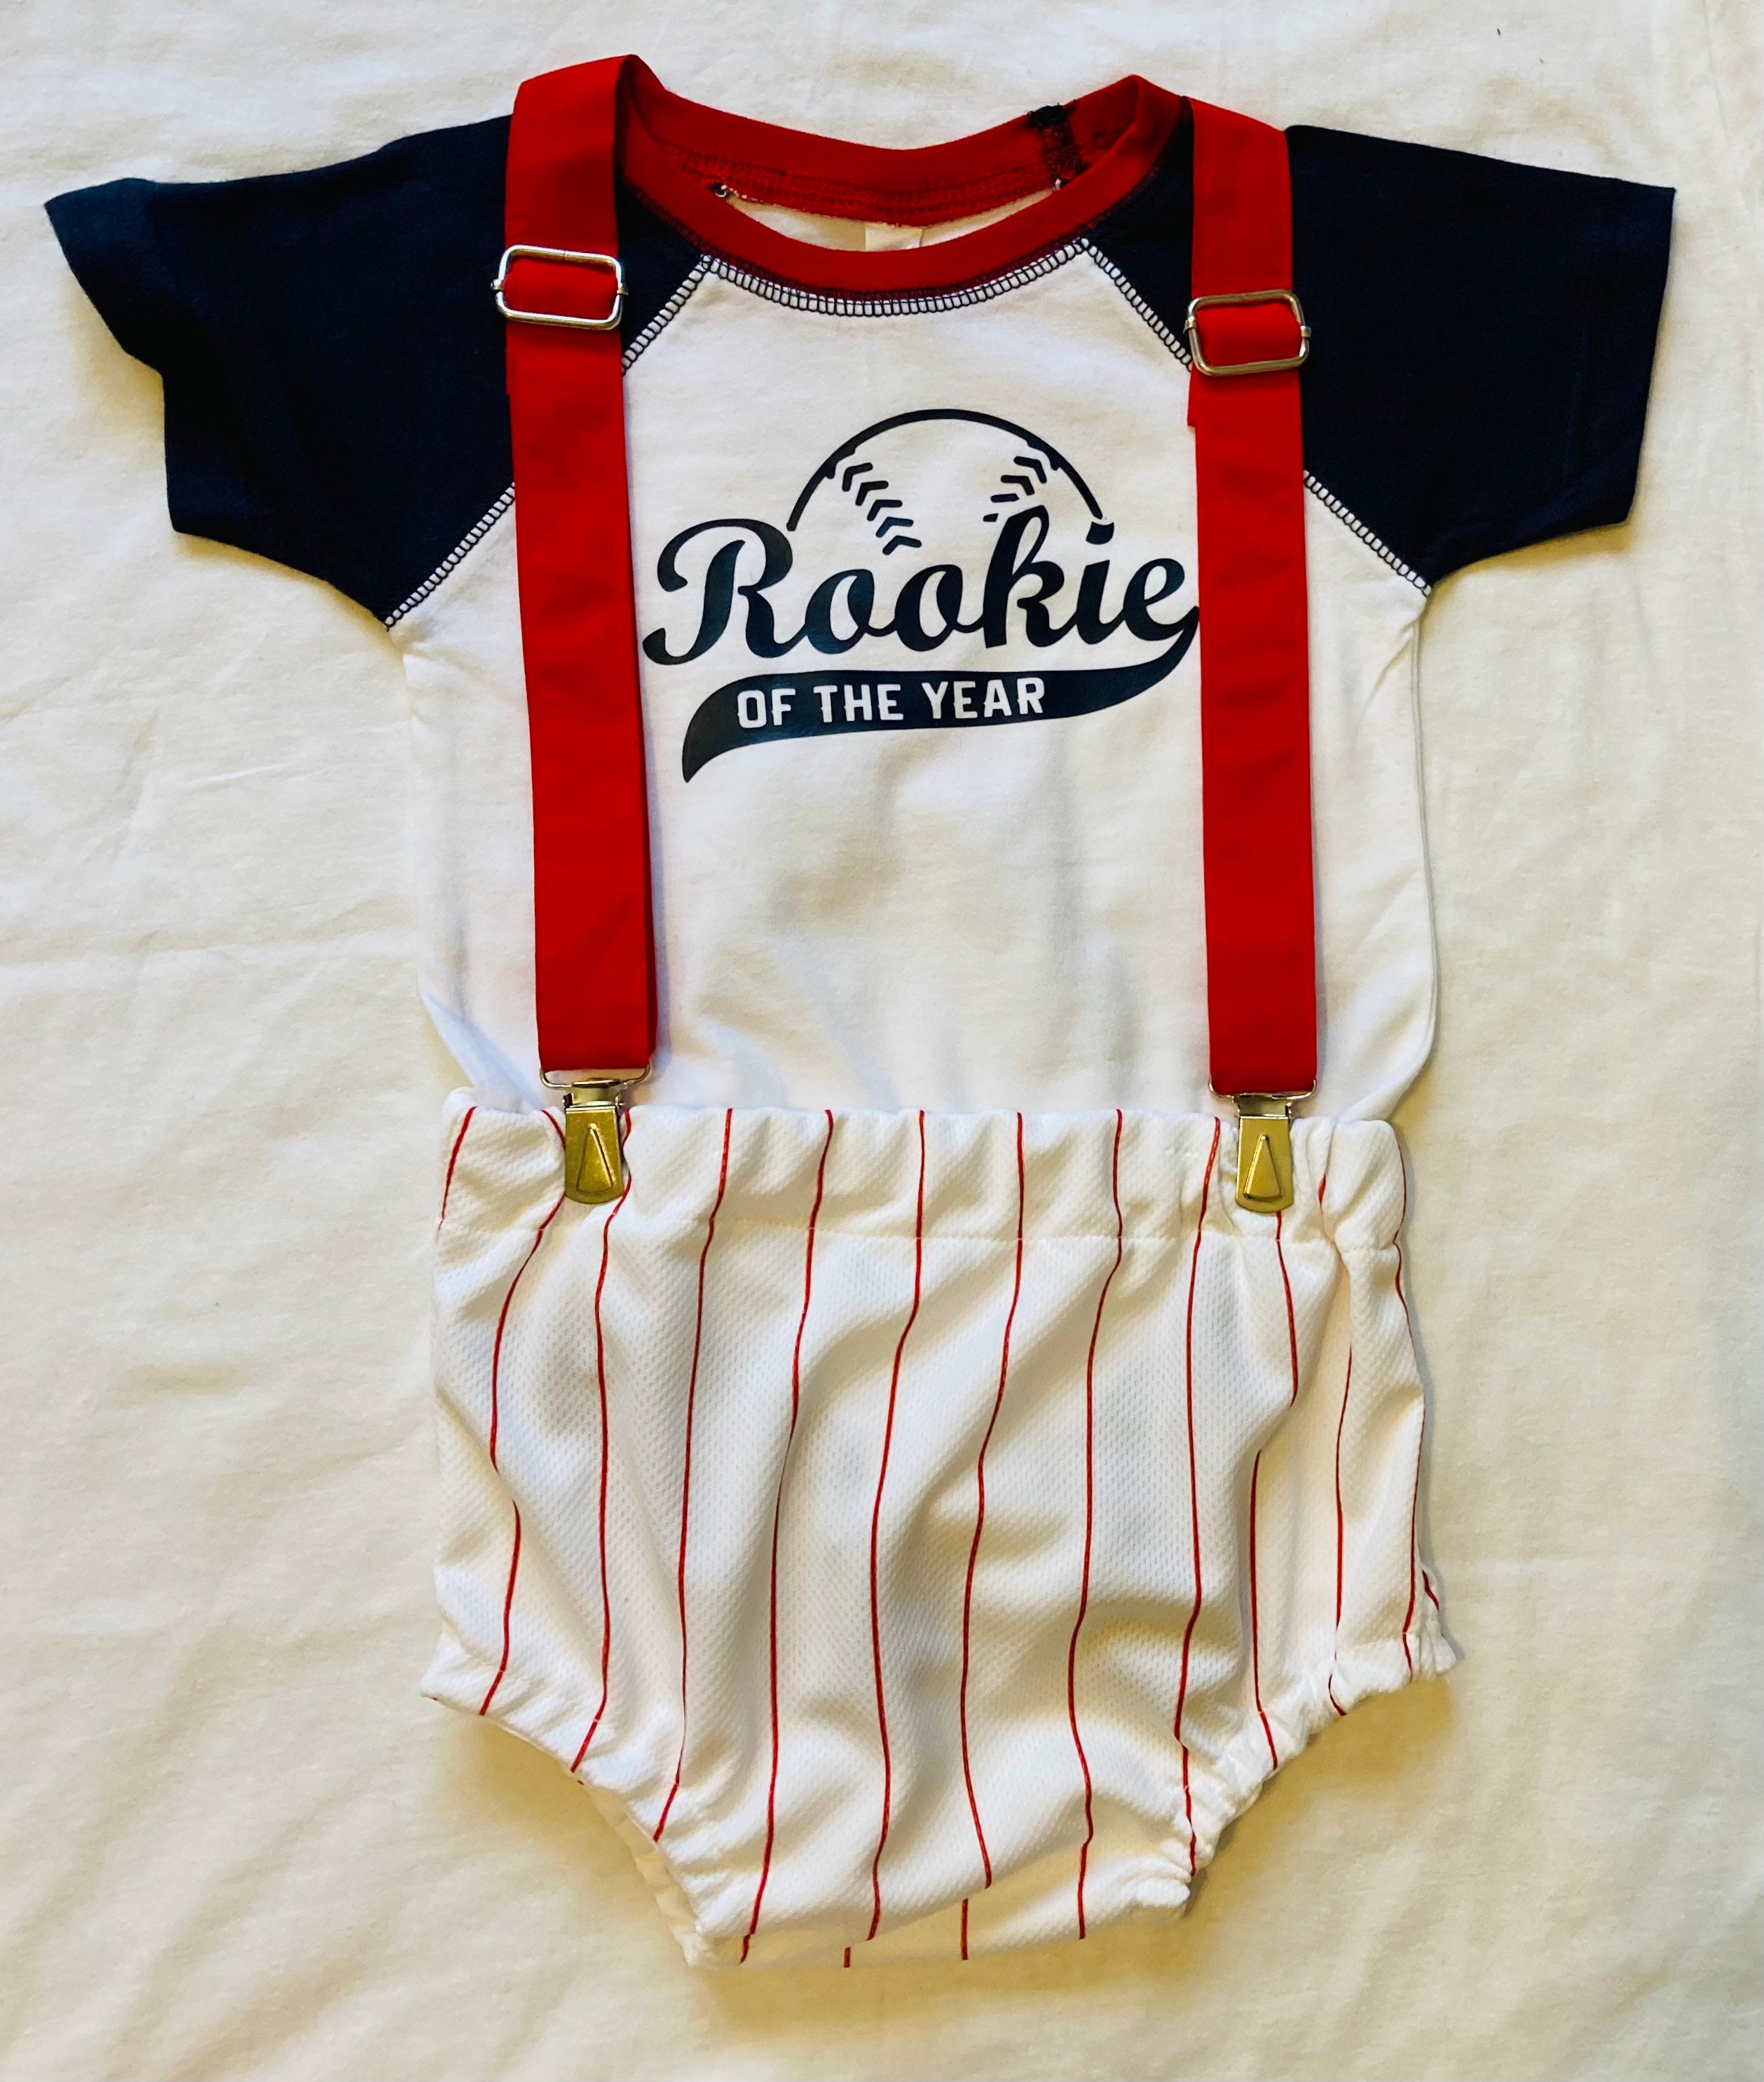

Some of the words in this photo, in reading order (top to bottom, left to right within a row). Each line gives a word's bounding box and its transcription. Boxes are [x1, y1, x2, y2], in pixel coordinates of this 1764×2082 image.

[642, 505, 1199, 666] Rookie
[737, 687, 797, 729] OF
[813, 683, 904, 722] THE
[922, 677, 1044, 720] YEAR
